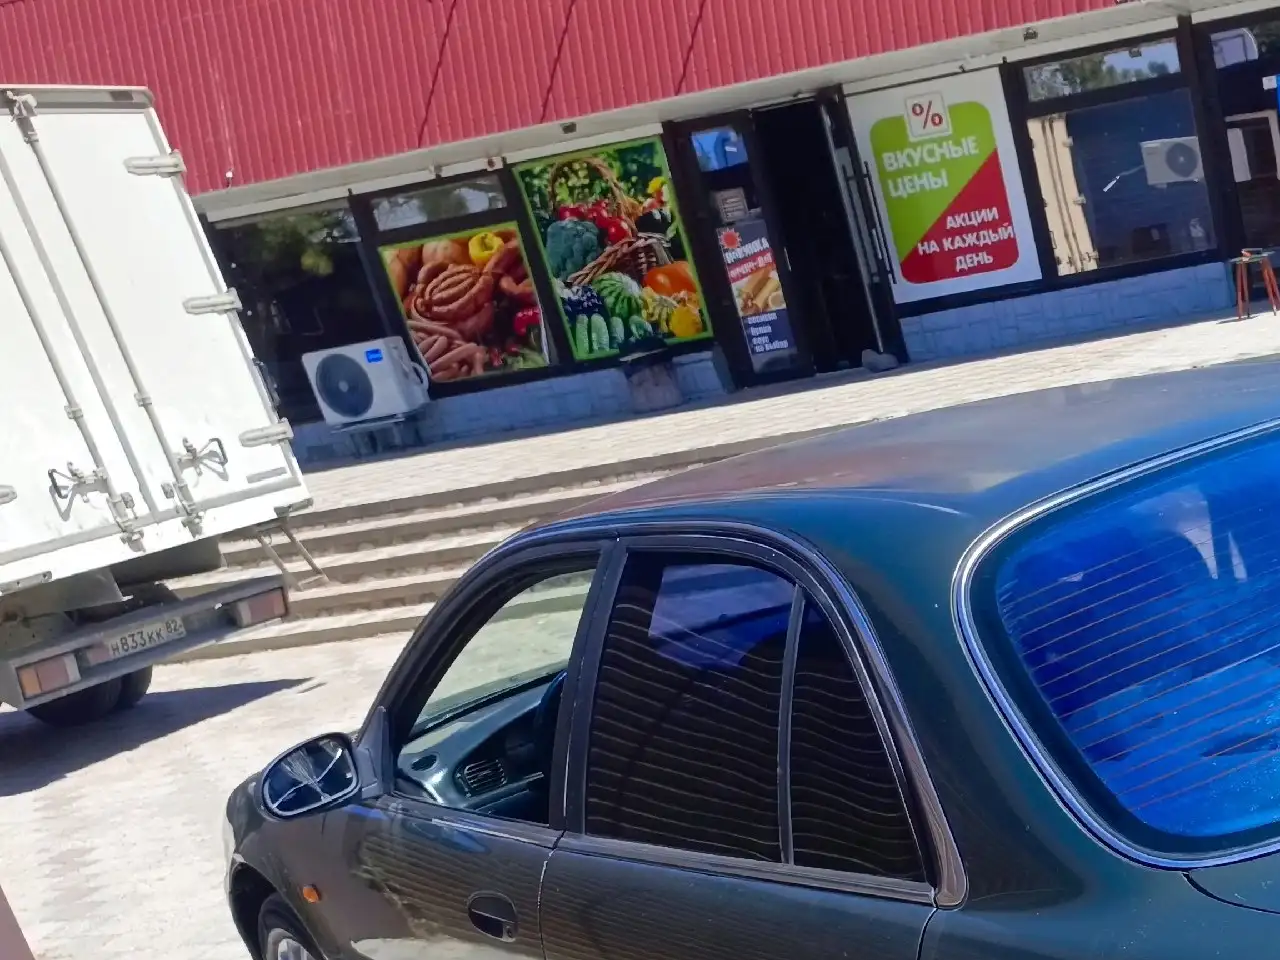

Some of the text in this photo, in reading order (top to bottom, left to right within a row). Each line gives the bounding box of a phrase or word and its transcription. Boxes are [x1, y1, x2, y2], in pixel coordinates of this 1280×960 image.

[882, 135, 980, 173] ВКУСНЫЕ
[888, 168, 949, 199] ЦЕНЫ
[945, 206, 999, 231] АКЦИИ
[917, 222, 1014, 256] НА КАЖДЫЙ
[955, 251, 994, 273] ДЕНЬ
